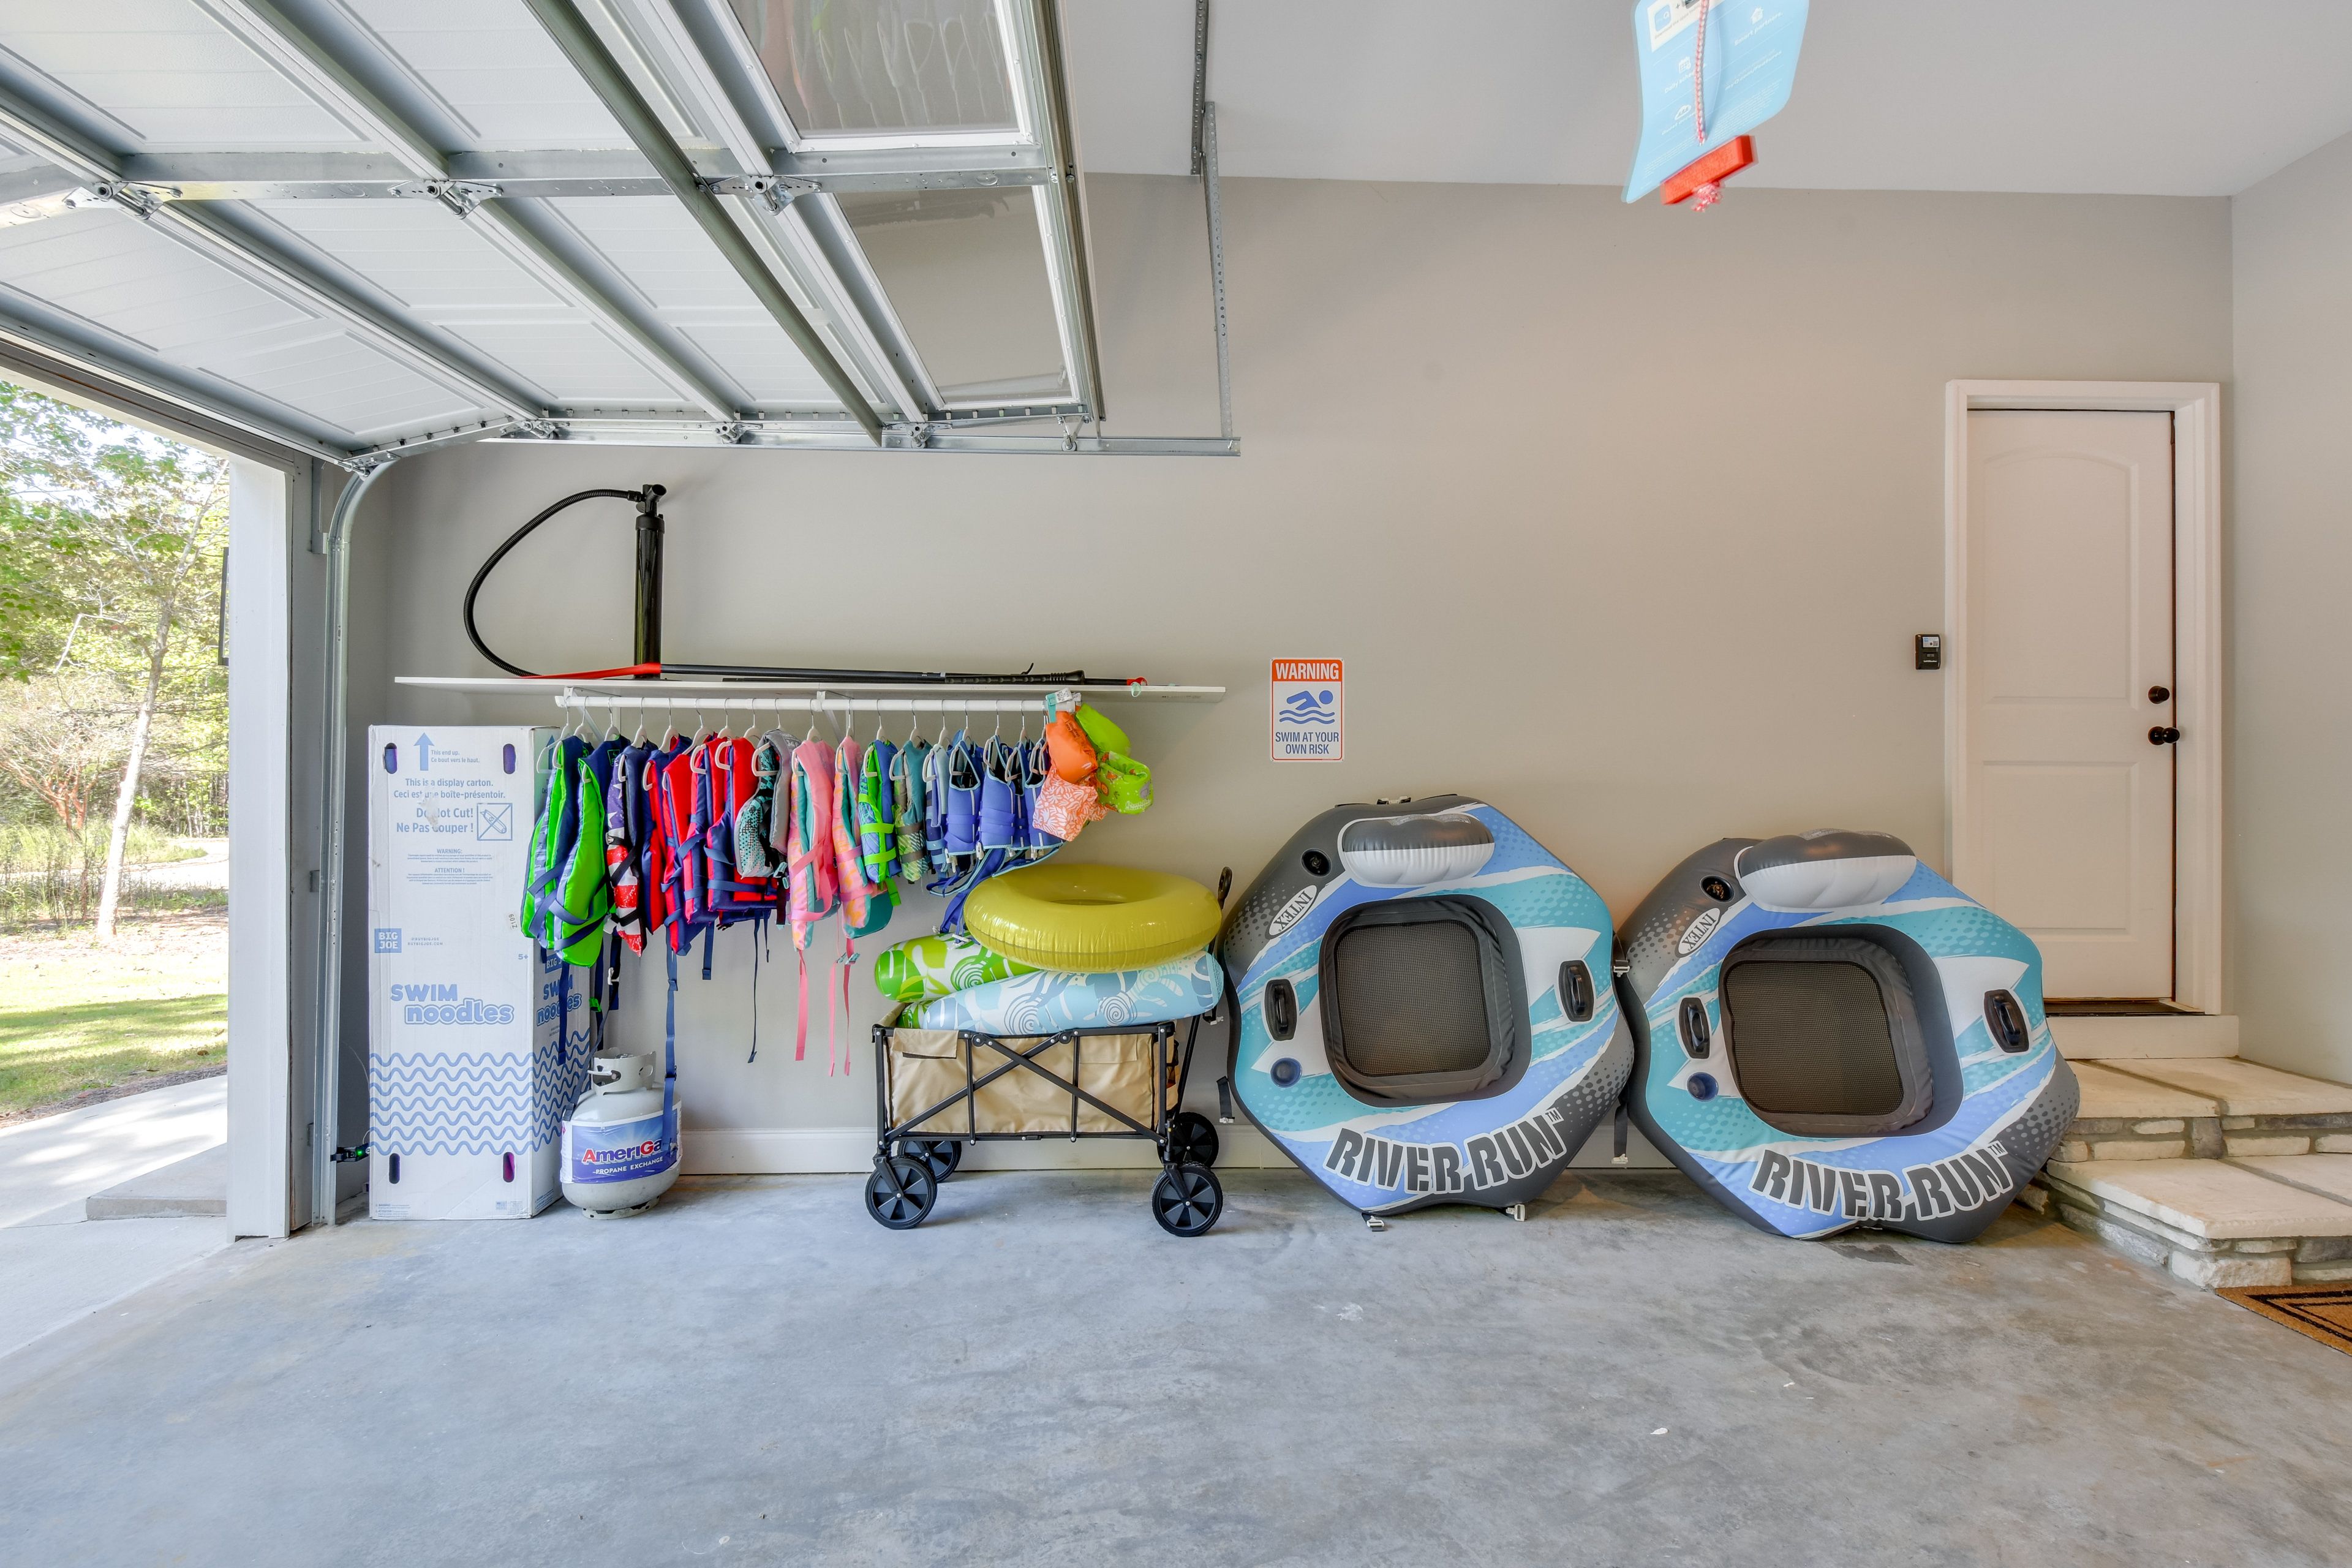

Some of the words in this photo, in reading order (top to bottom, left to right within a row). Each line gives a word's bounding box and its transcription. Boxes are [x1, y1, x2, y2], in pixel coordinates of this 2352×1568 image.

[1275, 663, 1340, 680] WARNING
[1275, 732, 1300, 742] SWIM
[1302, 732, 1313, 742] AT
[1315, 732, 1340, 742] YOUR
[1286, 744, 1307, 755] OWN
[1309, 744, 1329, 755] RISK
[405, 778, 421, 786] This
[423, 778, 429, 786] is
[437, 778, 464, 788] display
[466, 778, 494, 787] carton.
[394, 790, 410, 799] Ceci
[440, 790, 506, 800] boîte-présentoir.
[453, 807, 473, 818] Cut!
[396, 822, 410, 832] Ne
[413, 822, 430, 832] Pas
[1274, 891, 1313, 930] INTEX
[378, 932, 398, 940] BIG
[1681, 913, 1717, 949] INTEX
[379, 941, 398, 949] JOE
[546, 957, 557, 968] BIG
[390, 984, 458, 1002] SWIM
[543, 974, 574, 1000] SWM
[405, 999, 514, 1023] noodles
[582, 1139, 662, 1163] AmeriGa
[1325, 1127, 1463, 1192] RIVER
[595, 1166, 627, 1175] PROPANE
[630, 1156, 663, 1170] EXCHANGE
[1751, 1149, 1902, 1219] RIVER
